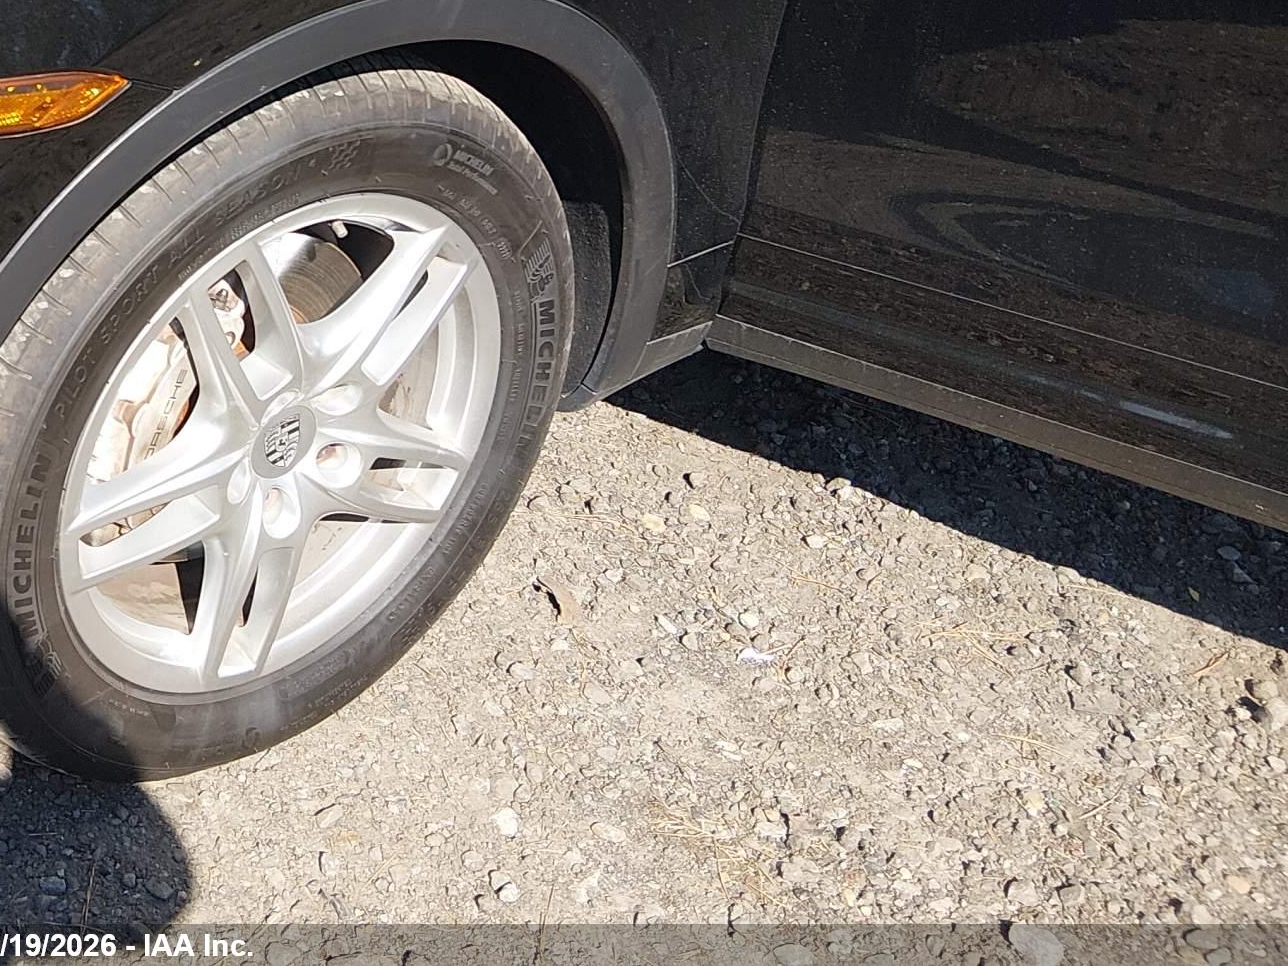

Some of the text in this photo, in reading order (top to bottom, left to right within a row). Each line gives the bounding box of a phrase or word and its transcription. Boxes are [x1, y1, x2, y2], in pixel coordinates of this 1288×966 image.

[54, 352, 98, 418] PILOT
[101, 264, 160, 345] SPORT
[515, 298, 556, 458] MICHELIN
[13, 451, 53, 639] MICHELIN
